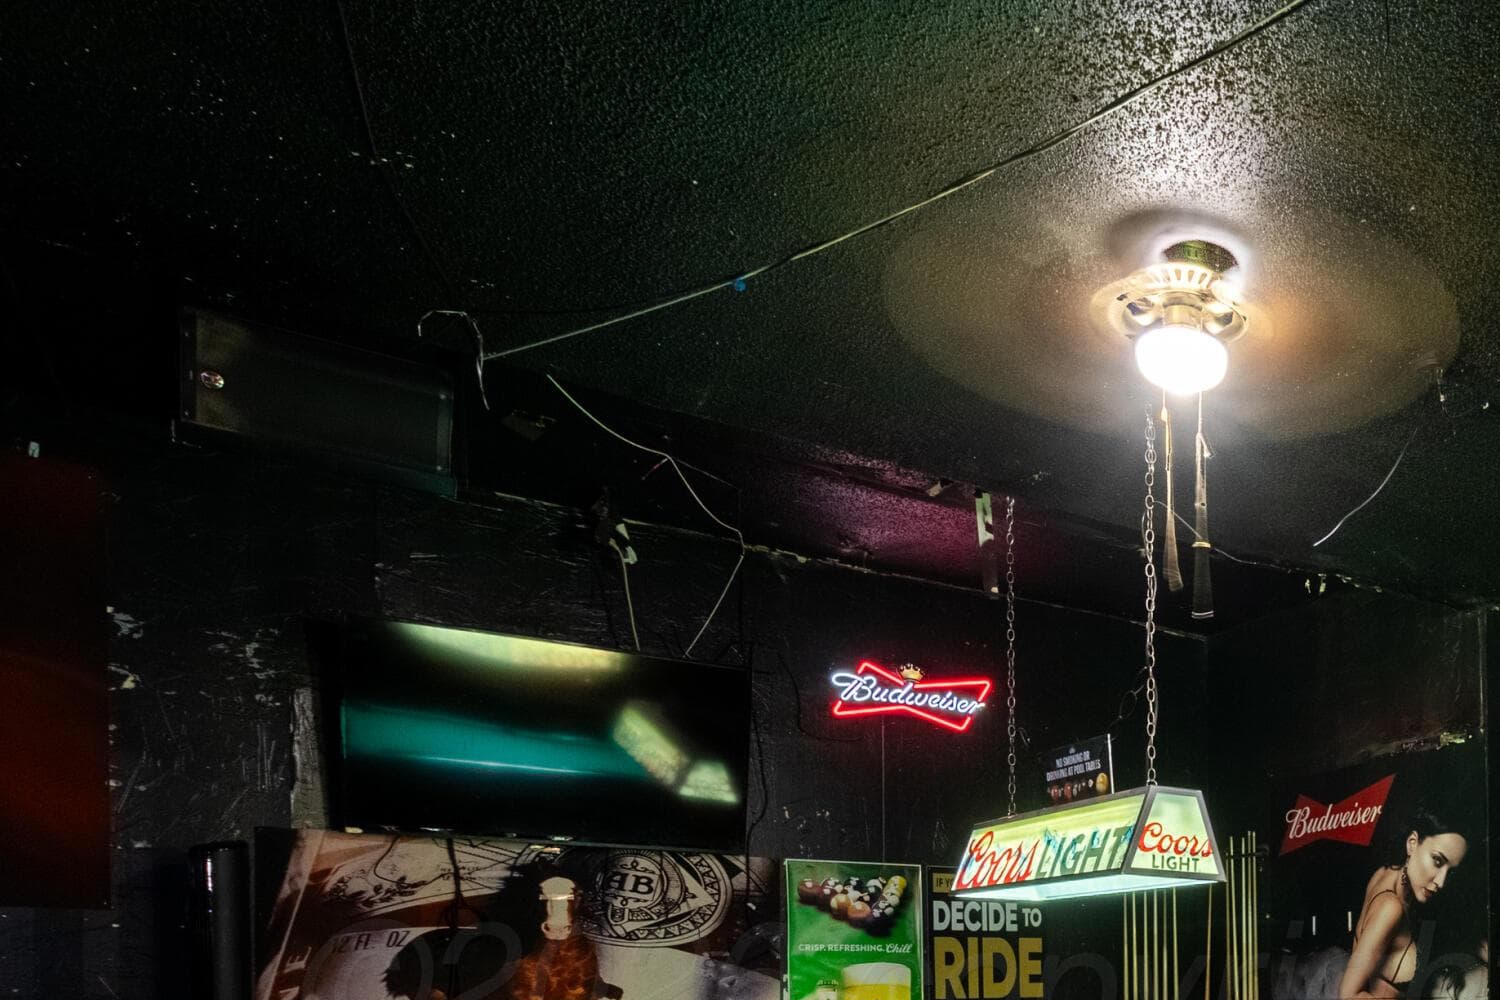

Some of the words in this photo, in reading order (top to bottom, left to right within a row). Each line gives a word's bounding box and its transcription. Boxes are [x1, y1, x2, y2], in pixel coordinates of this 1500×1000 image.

[832, 671, 986, 715] Budweiser
[1138, 822, 1214, 858] Coors
[1286, 803, 1383, 840] Budweiser
[955, 830, 1040, 891] Coors
[1037, 823, 1134, 880] LIGHT
[1151, 855, 1200, 873] LIGHT
[932, 901, 1018, 932] DECIDE
[1022, 908, 1042, 928] TO
[799, 943, 827, 952] CRISP.
[827, 943, 884, 953] REFRESHING.
[884, 942, 913, 954] Chill
[933, 936, 1045, 1000] RIDE
